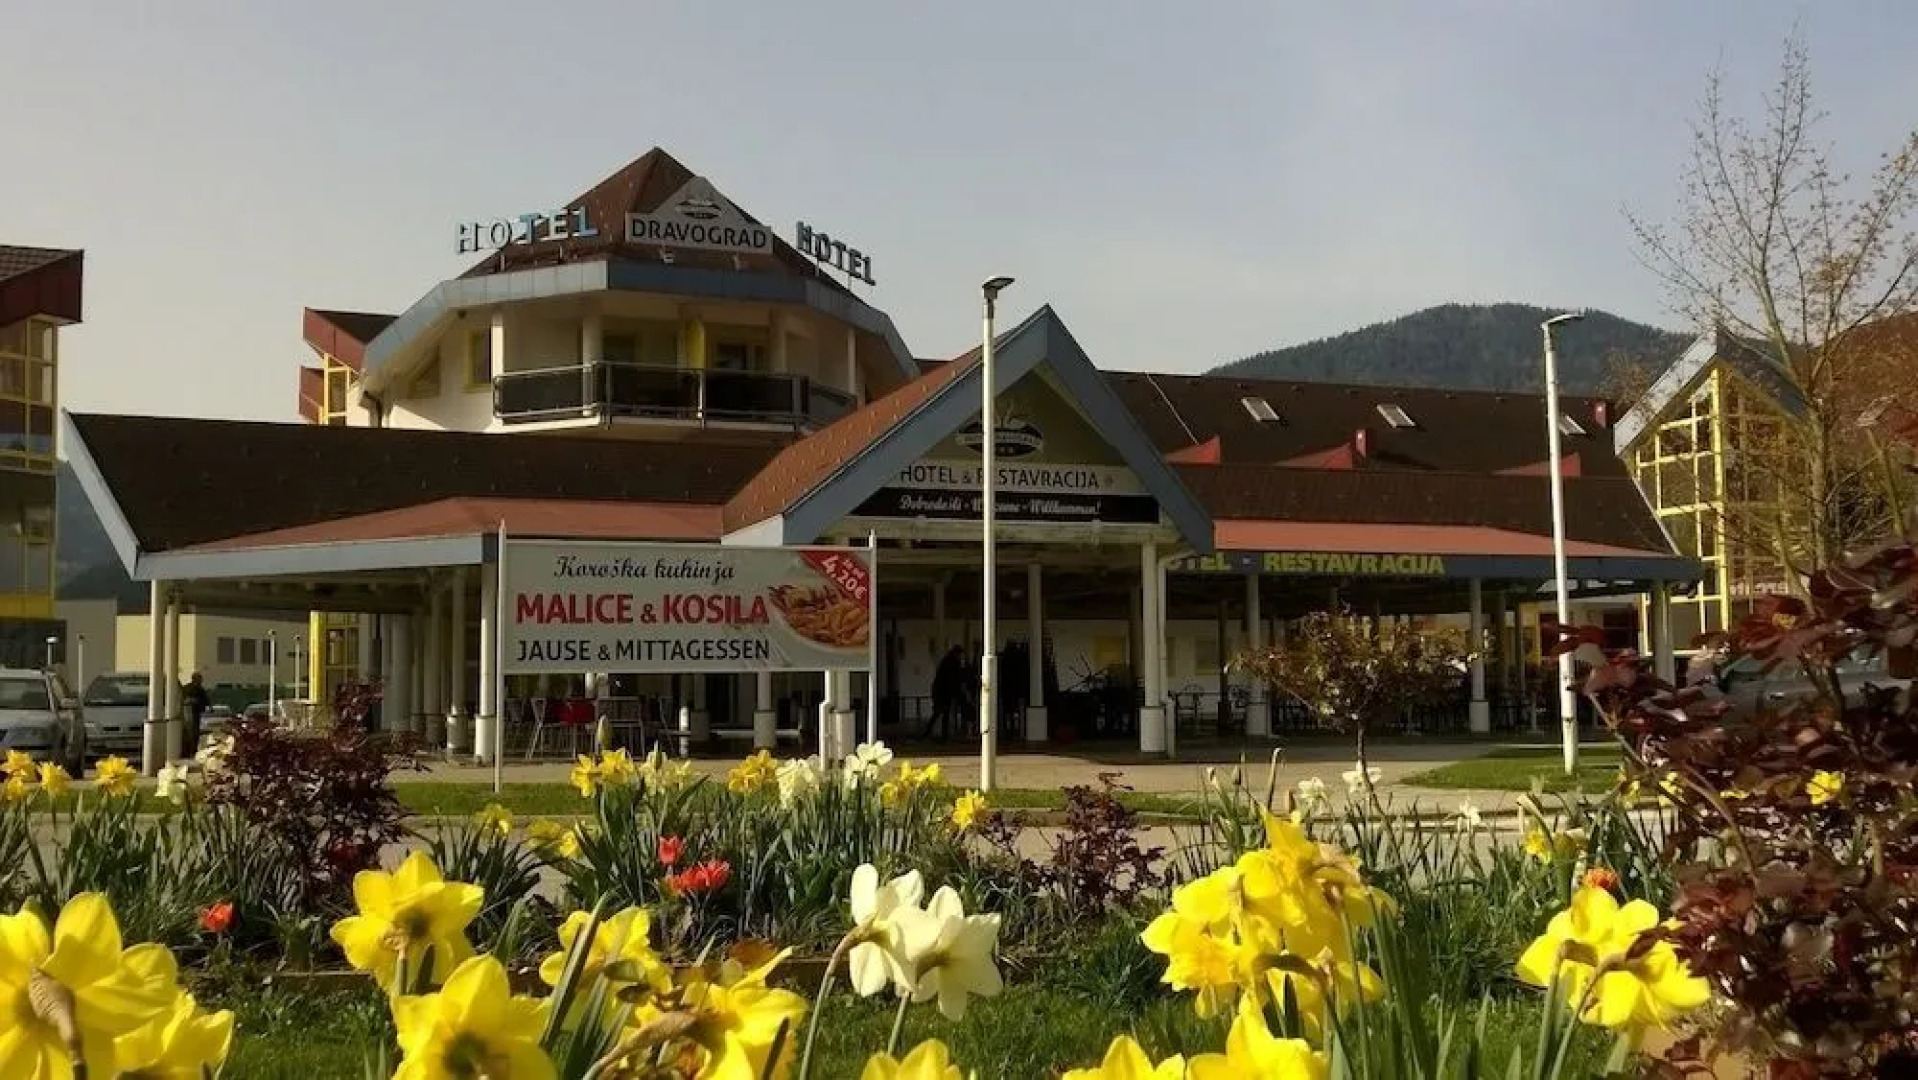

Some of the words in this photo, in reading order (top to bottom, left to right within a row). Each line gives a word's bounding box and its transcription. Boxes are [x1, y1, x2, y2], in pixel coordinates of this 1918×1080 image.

[455, 206, 599, 253] HOTEL
[632, 218, 767, 248] DRAVOGRAD
[796, 220, 876, 286] HOTEL
[901, 465, 957, 485] HOTEL
[963, 474, 972, 484] &
[977, 467, 1100, 489] RSTAVRACIJA
[553, 555, 648, 579] Koroška
[654, 557, 735, 585] kuhinja
[516, 593, 633, 624] MALICE
[640, 603, 657, 624] &
[663, 595, 769, 625] KOSILA
[517, 640, 591, 661] JAUSE
[597, 643, 610, 661] &
[615, 639, 770, 661] MITTAGESSEN
